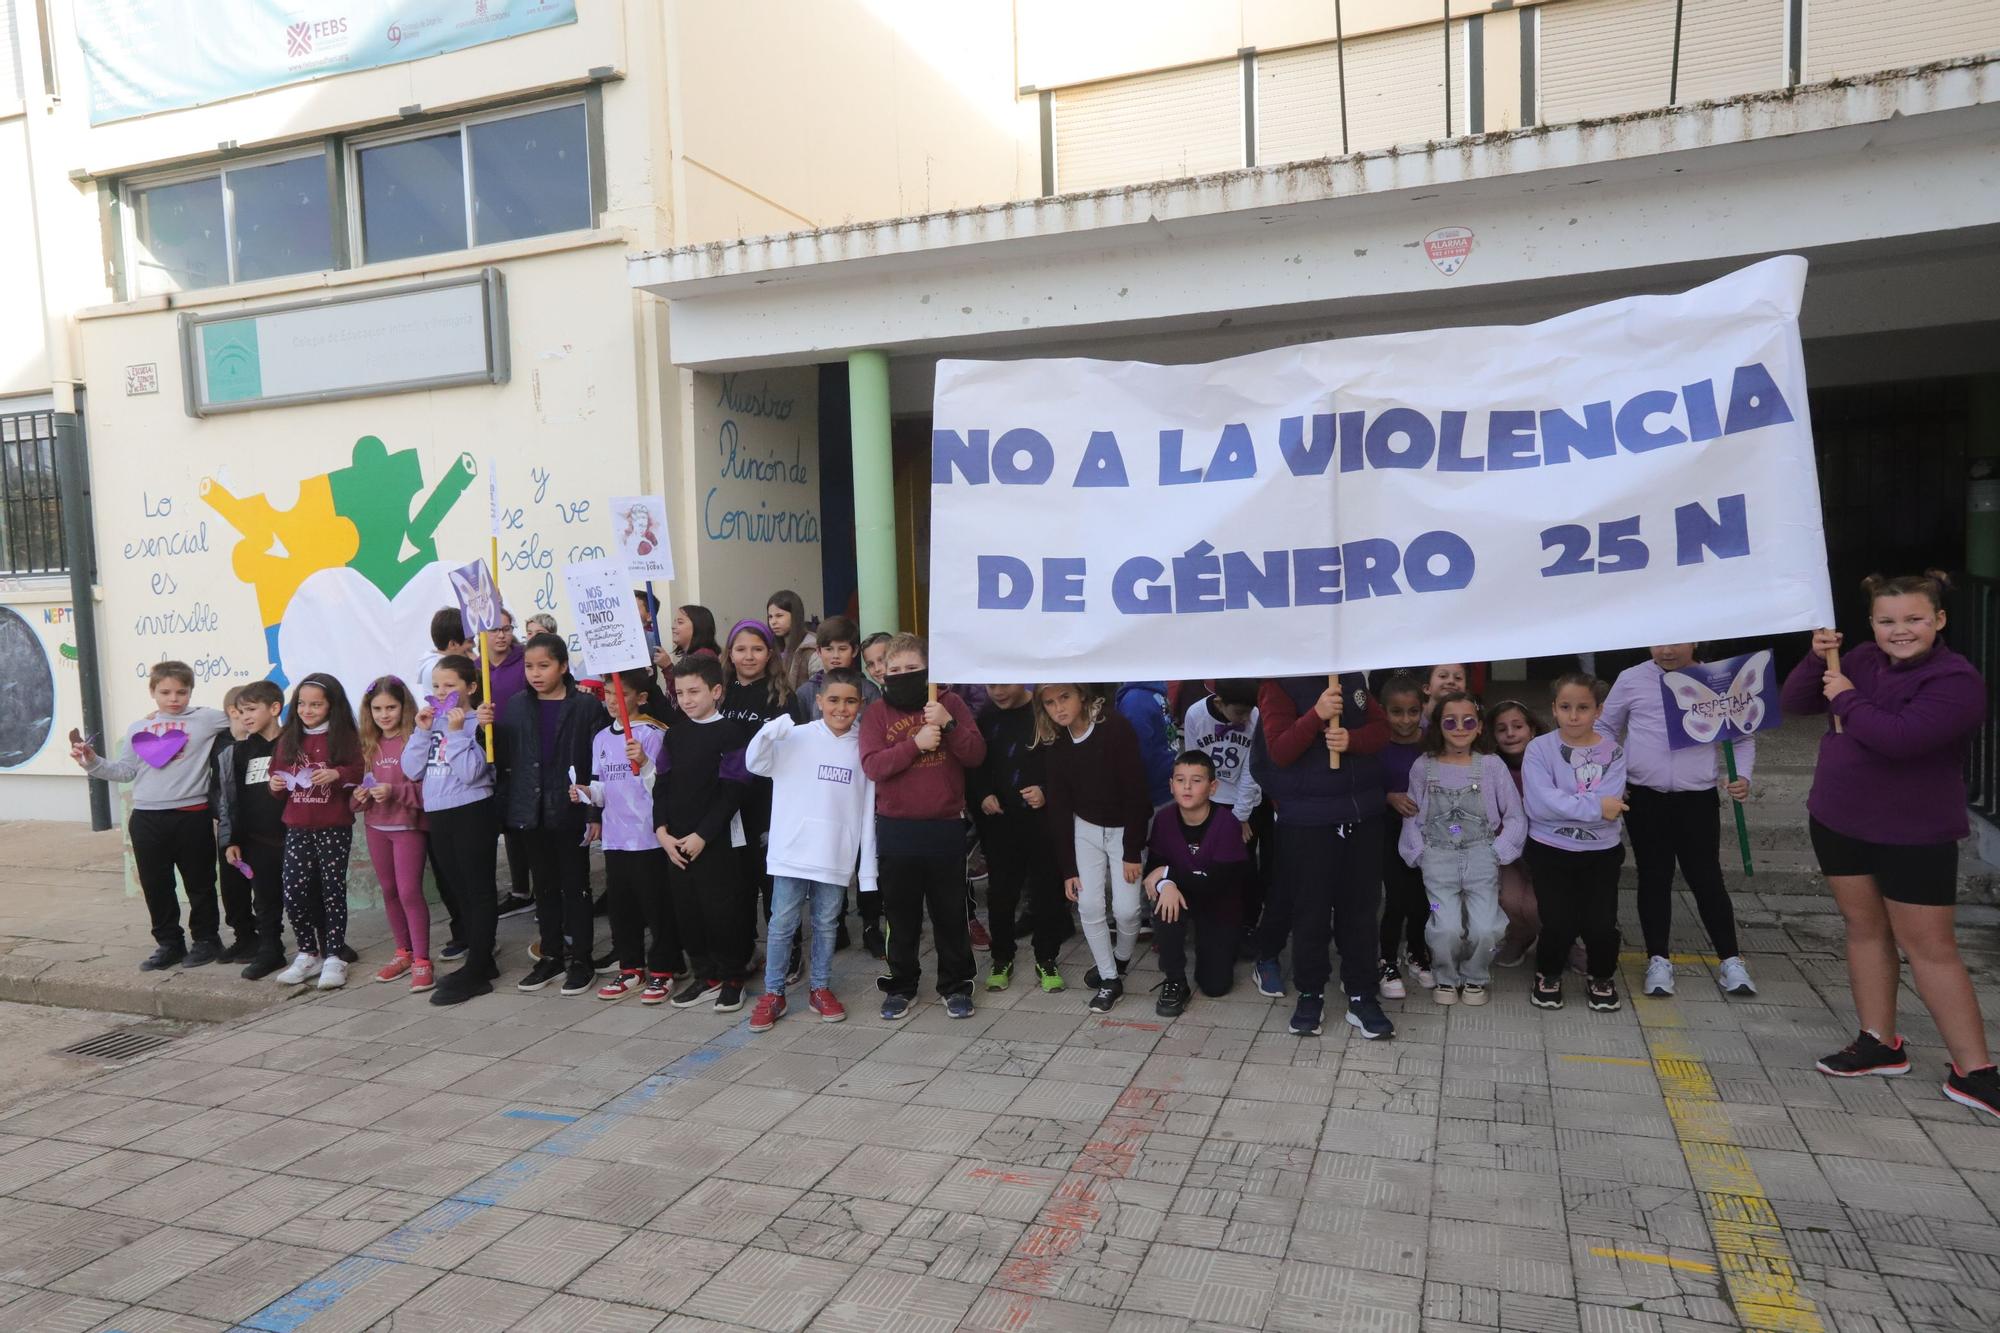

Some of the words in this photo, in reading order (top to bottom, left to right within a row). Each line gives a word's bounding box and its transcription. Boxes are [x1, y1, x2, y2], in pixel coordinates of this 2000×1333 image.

[314, 17, 348, 38] FEBS
[1431, 238, 1468, 250] ALARMA
[717, 372, 794, 420] Nuestro
[932, 427, 1055, 486] NO
[1072, 431, 1130, 488] A
[1159, 422, 1258, 486] LA
[1278, 361, 1795, 477] VIOLENCIA
[719, 419, 787, 482] Rincón
[789, 434, 808, 485] de
[530, 466, 551, 504] y
[143, 491, 173, 518] Lo
[501, 507, 524, 530] se
[555, 499, 591, 524] ve
[704, 487, 821, 543] Convivencia
[124, 521, 210, 560] esencial
[501, 532, 555, 571] sólo
[977, 555, 1087, 613] DE
[1111, 530, 1475, 614] GÉNERO
[1540, 514, 1650, 578] 25
[1674, 493, 1751, 567] N
[151, 572, 178, 595] es
[534, 571, 558, 611] el
[585, 586, 603, 599] NOS
[44, 607, 74, 624] NEPT
[135, 601, 219, 636] invisible
[578, 596, 621, 614] QUITARON
[587, 610, 615, 625] TANTO
[136, 662, 151, 678] a
[886, 715, 915, 742] STONY
[375, 757, 399, 766] LAUGH
[1211, 746, 1240, 769] 58
[819, 765, 852, 784] MARVEL
